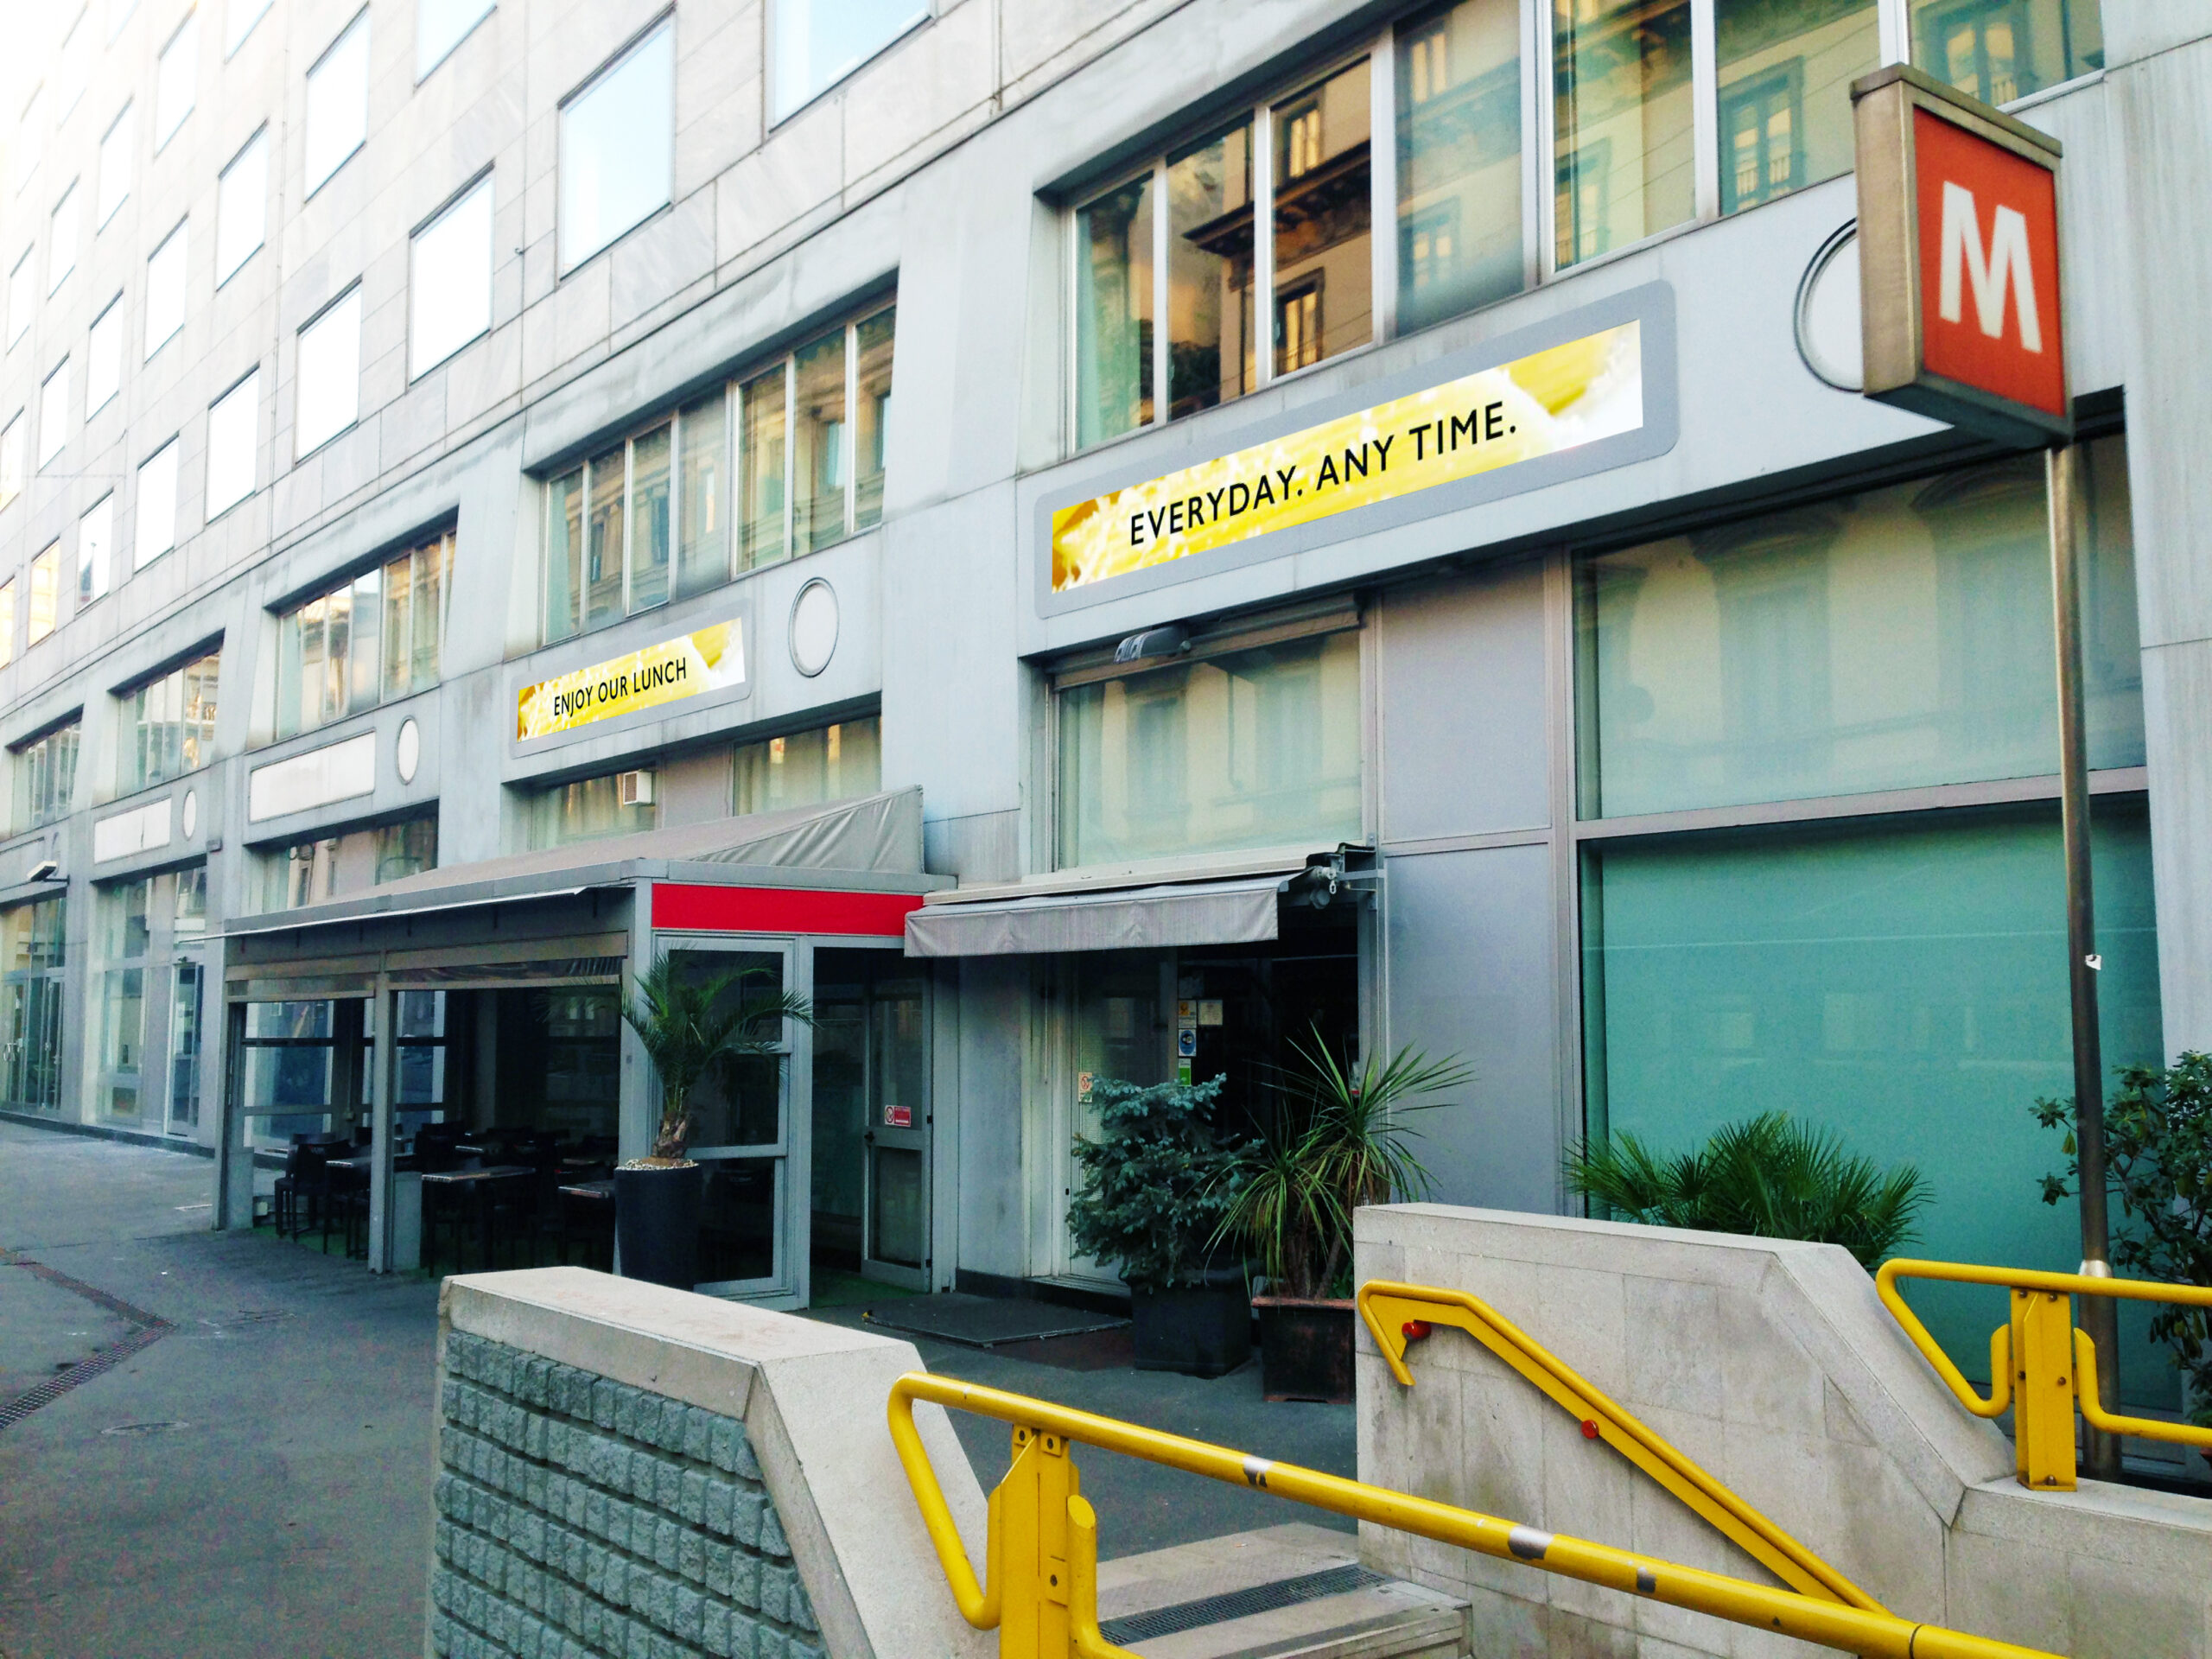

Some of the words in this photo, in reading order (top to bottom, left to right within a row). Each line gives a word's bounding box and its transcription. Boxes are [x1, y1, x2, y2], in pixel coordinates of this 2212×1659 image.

[1939, 180, 2043, 353] M
[1130, 465, 1303, 546] EVERYDAY.
[1316, 435, 1395, 491] ANY
[1408, 401, 1516, 461] TIME.
[554, 685, 594, 717] ENJOY
[598, 676, 628, 703] OUR
[633, 657, 686, 694] LUNCH
